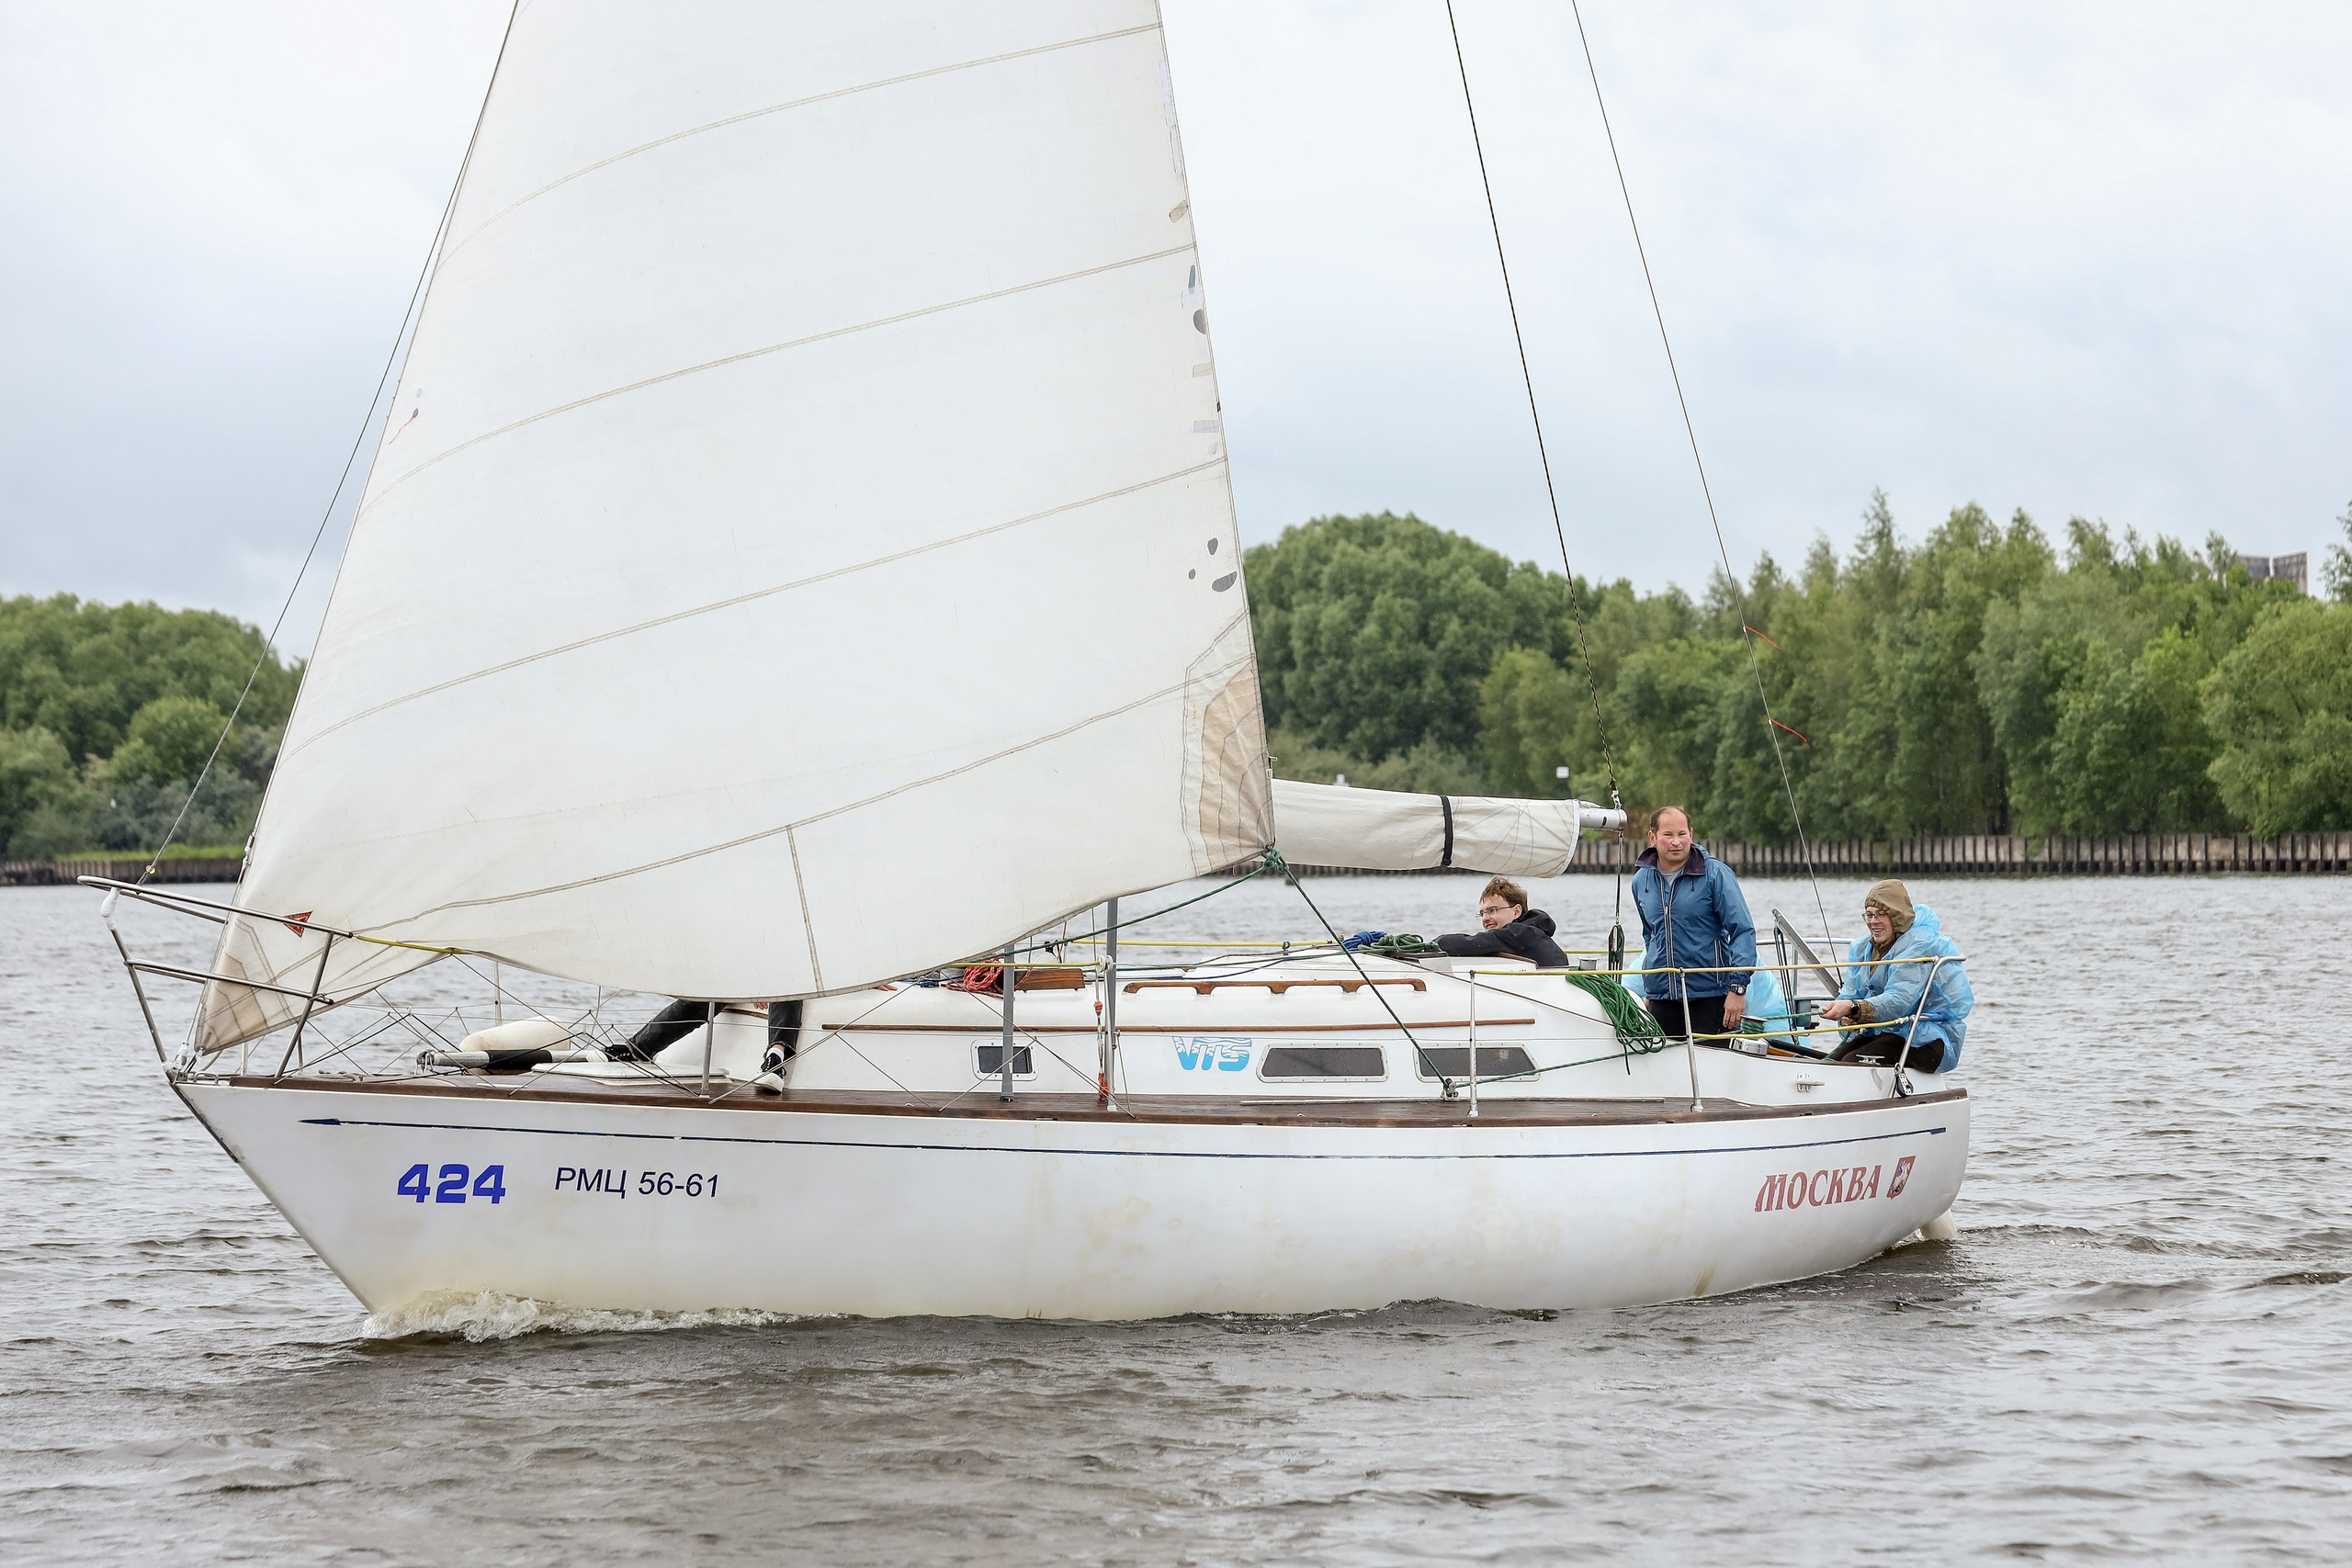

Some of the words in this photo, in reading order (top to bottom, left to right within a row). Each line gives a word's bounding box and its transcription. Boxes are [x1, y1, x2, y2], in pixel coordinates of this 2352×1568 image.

[397, 1164, 506, 1203] 424
[554, 1167, 628, 1200] РМЦ
[638, 1171, 719, 1198] 56-61
[1755, 1165, 1883, 1213] МОСКВА
